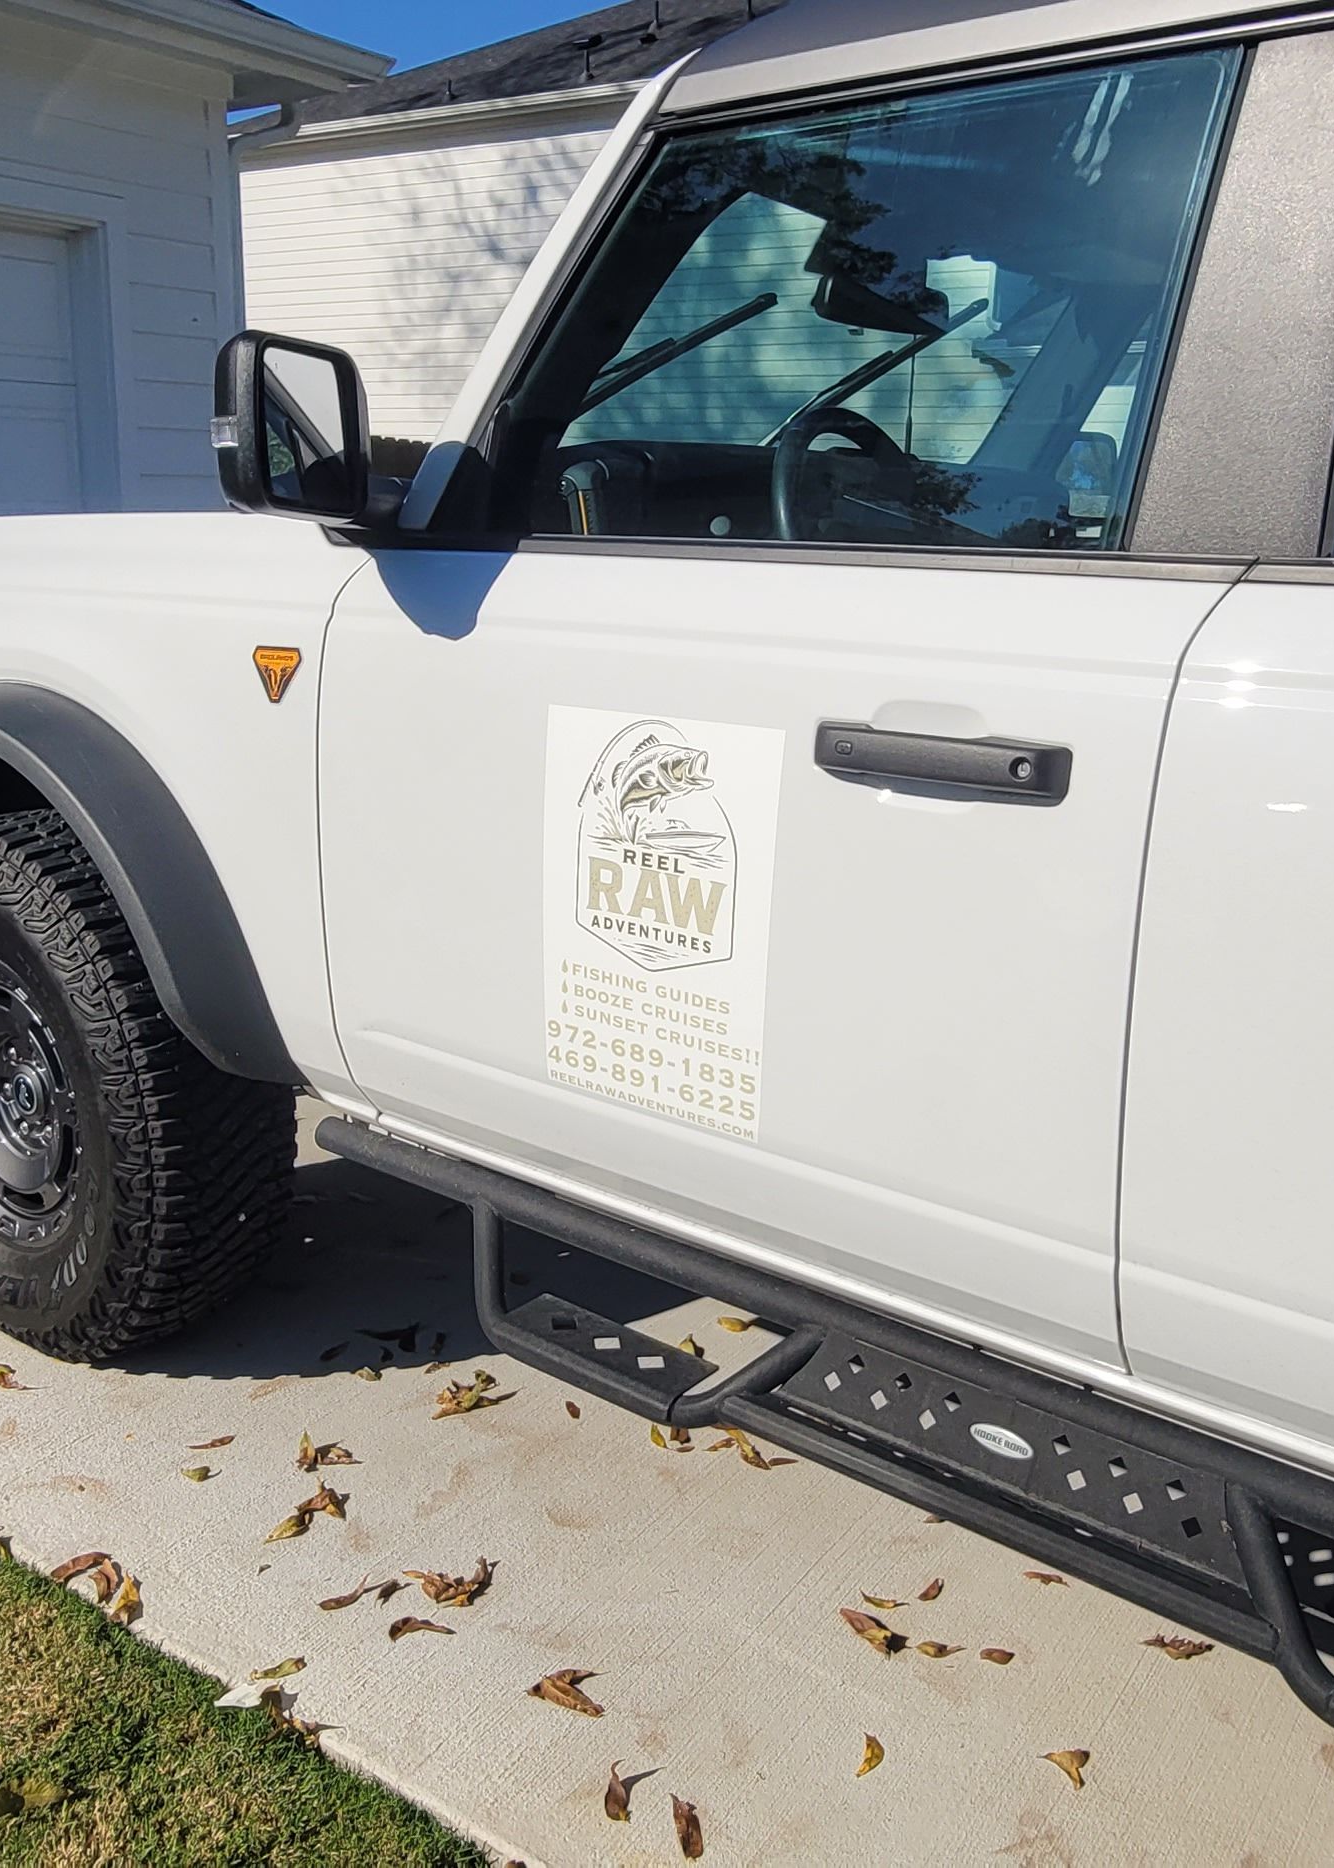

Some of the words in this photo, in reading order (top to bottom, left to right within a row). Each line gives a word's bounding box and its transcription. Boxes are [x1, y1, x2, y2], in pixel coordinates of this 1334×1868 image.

[622, 848, 685, 874] REEL
[586, 855, 728, 937] RAW
[591, 915, 712, 954] ADVENTURES
[572, 963, 647, 993] FISHING
[655, 985, 730, 1015] GUIDES
[574, 983, 633, 1011] BOOZE
[641, 1002, 728, 1036] CRUISES
[547, 1019, 756, 1095] 972-689-1835
[574, 1004, 648, 1035] SUNSET
[655, 1027, 760, 1066] CRUISES!!
[547, 1045, 755, 1122] 469-891-6225
[550, 1069, 755, 1140] REELRAWADVENTURES.COM
[974, 1428, 1003, 1445] HOOKE
